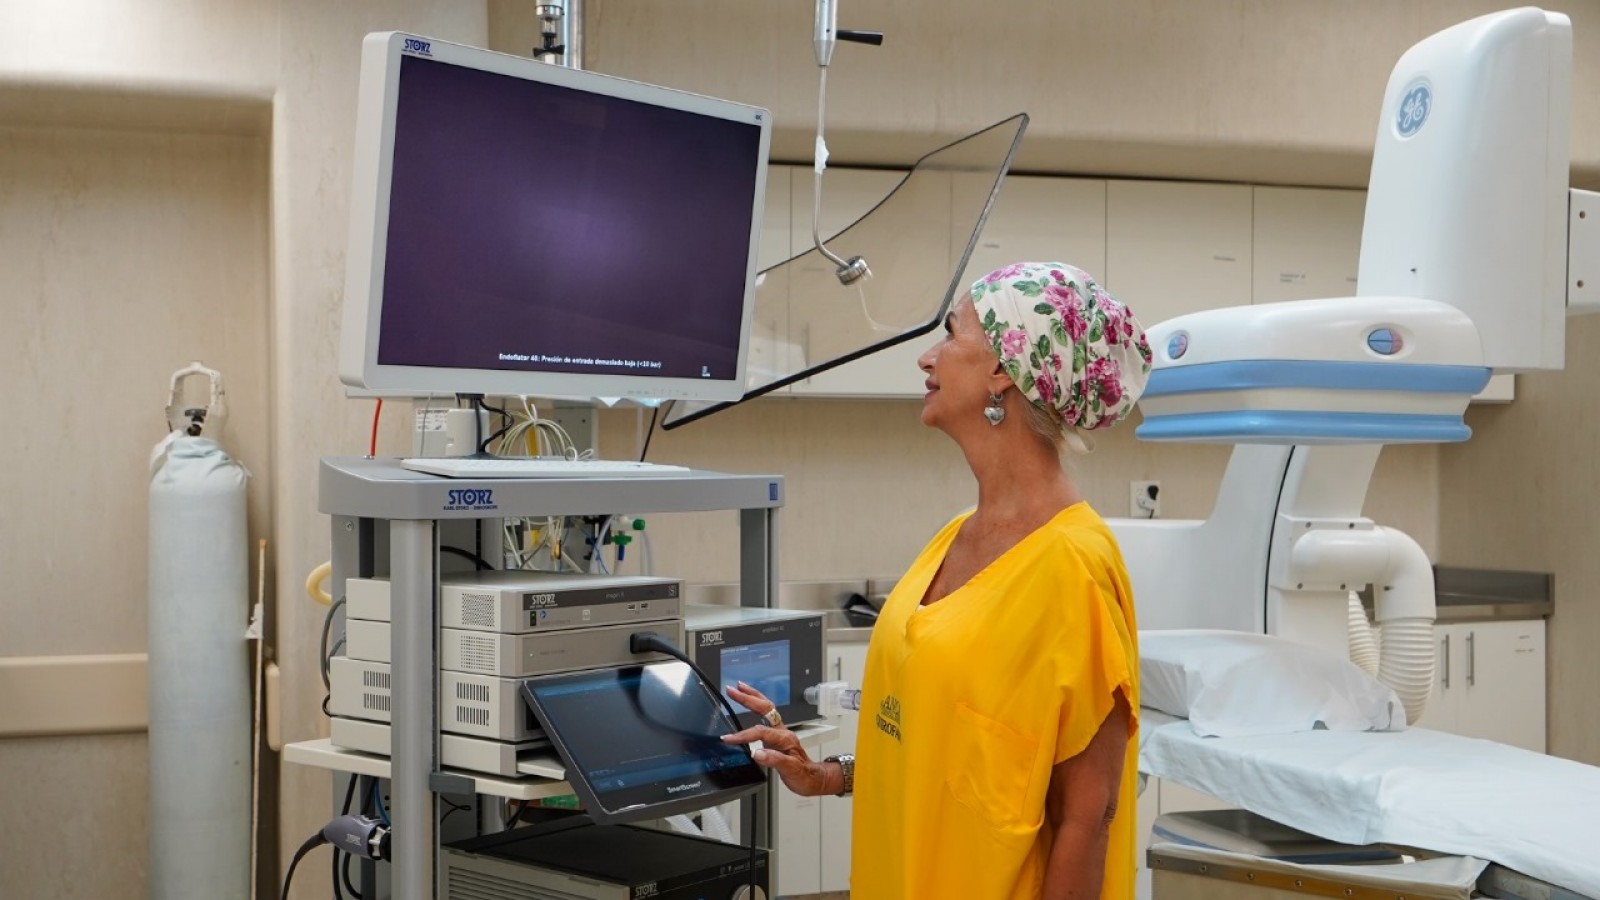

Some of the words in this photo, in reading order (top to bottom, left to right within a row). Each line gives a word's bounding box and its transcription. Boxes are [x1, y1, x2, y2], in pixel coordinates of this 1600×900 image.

[404, 38, 431, 53] STORZ
[448, 489, 493, 505] STORZ
[531, 594, 556, 605] STORZ
[701, 631, 723, 643] STORZ
[635, 882, 657, 897] STORZ
